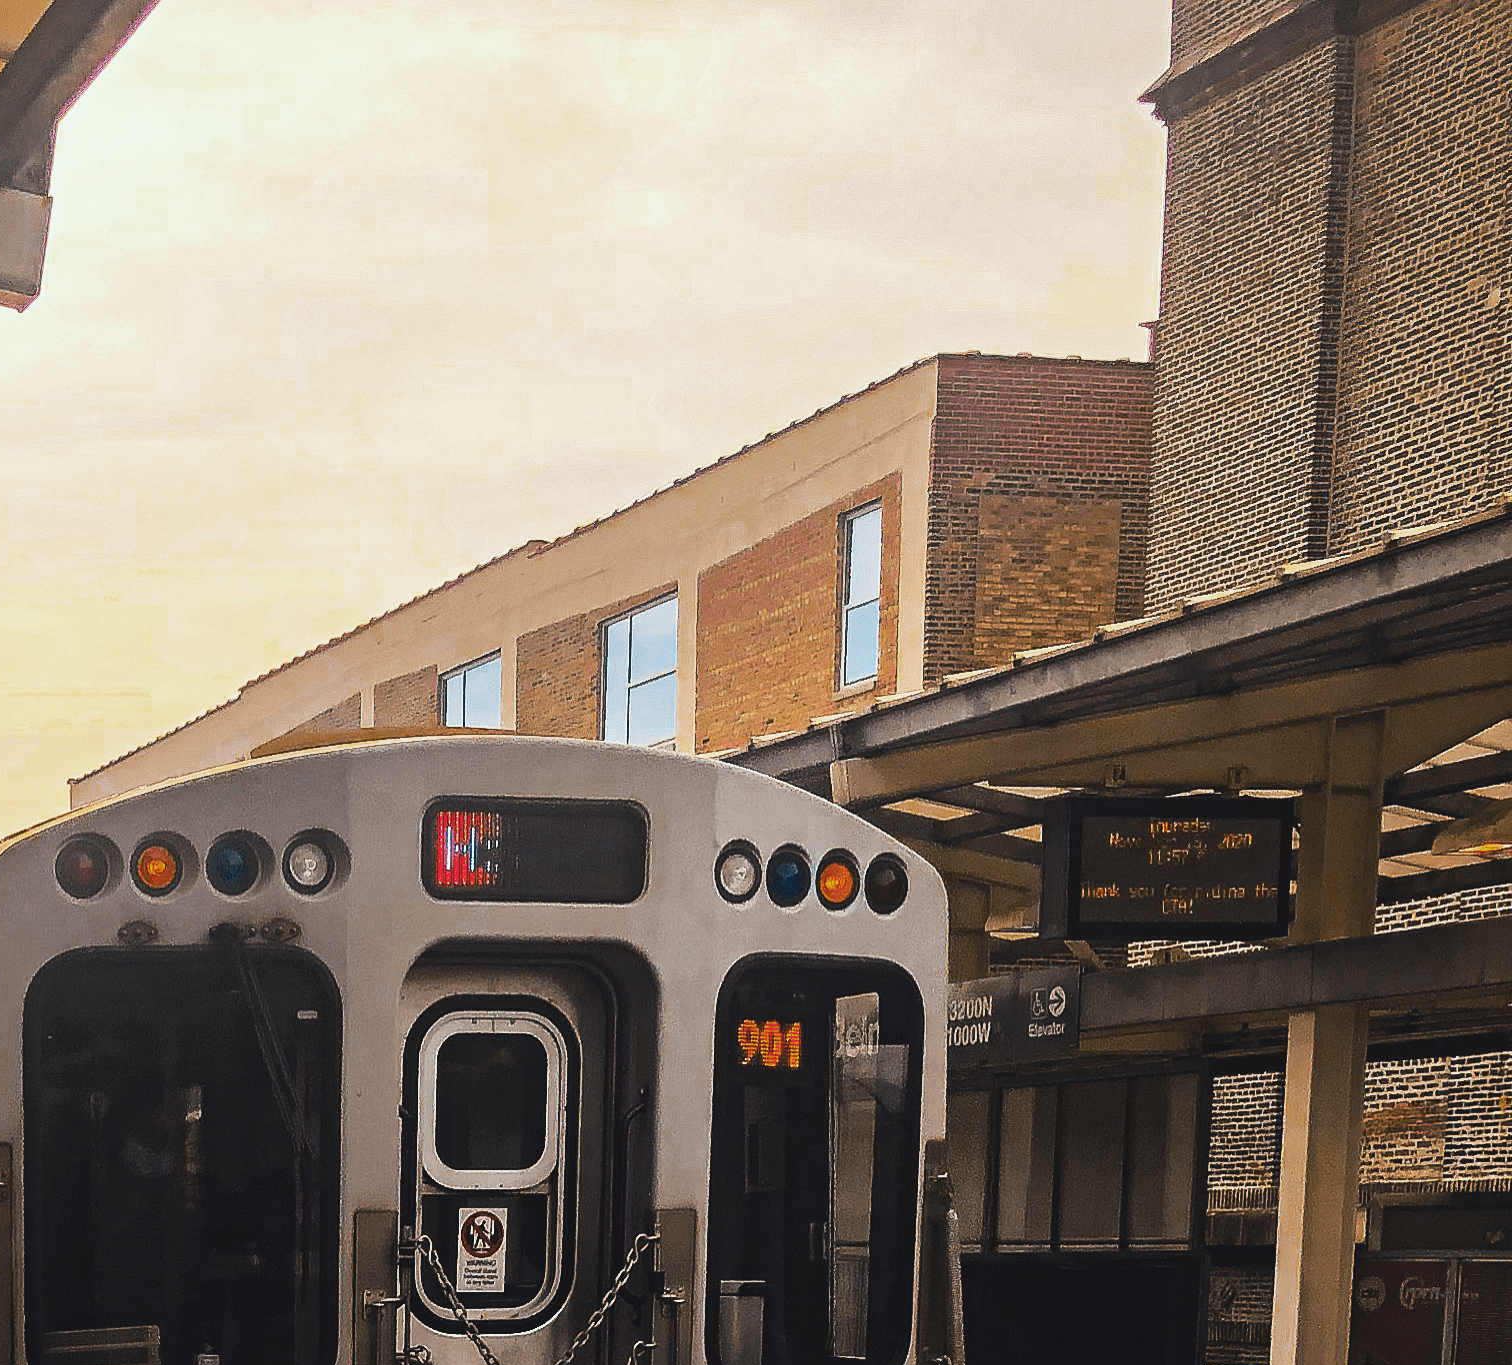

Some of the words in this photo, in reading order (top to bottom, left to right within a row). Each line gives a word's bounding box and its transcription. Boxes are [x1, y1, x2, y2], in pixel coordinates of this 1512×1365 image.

[949, 995, 994, 1021] 3200N
[737, 1019, 801, 1068] 901
[947, 1021, 992, 1047] 1000W
[1028, 1022, 1066, 1038] Elevator
